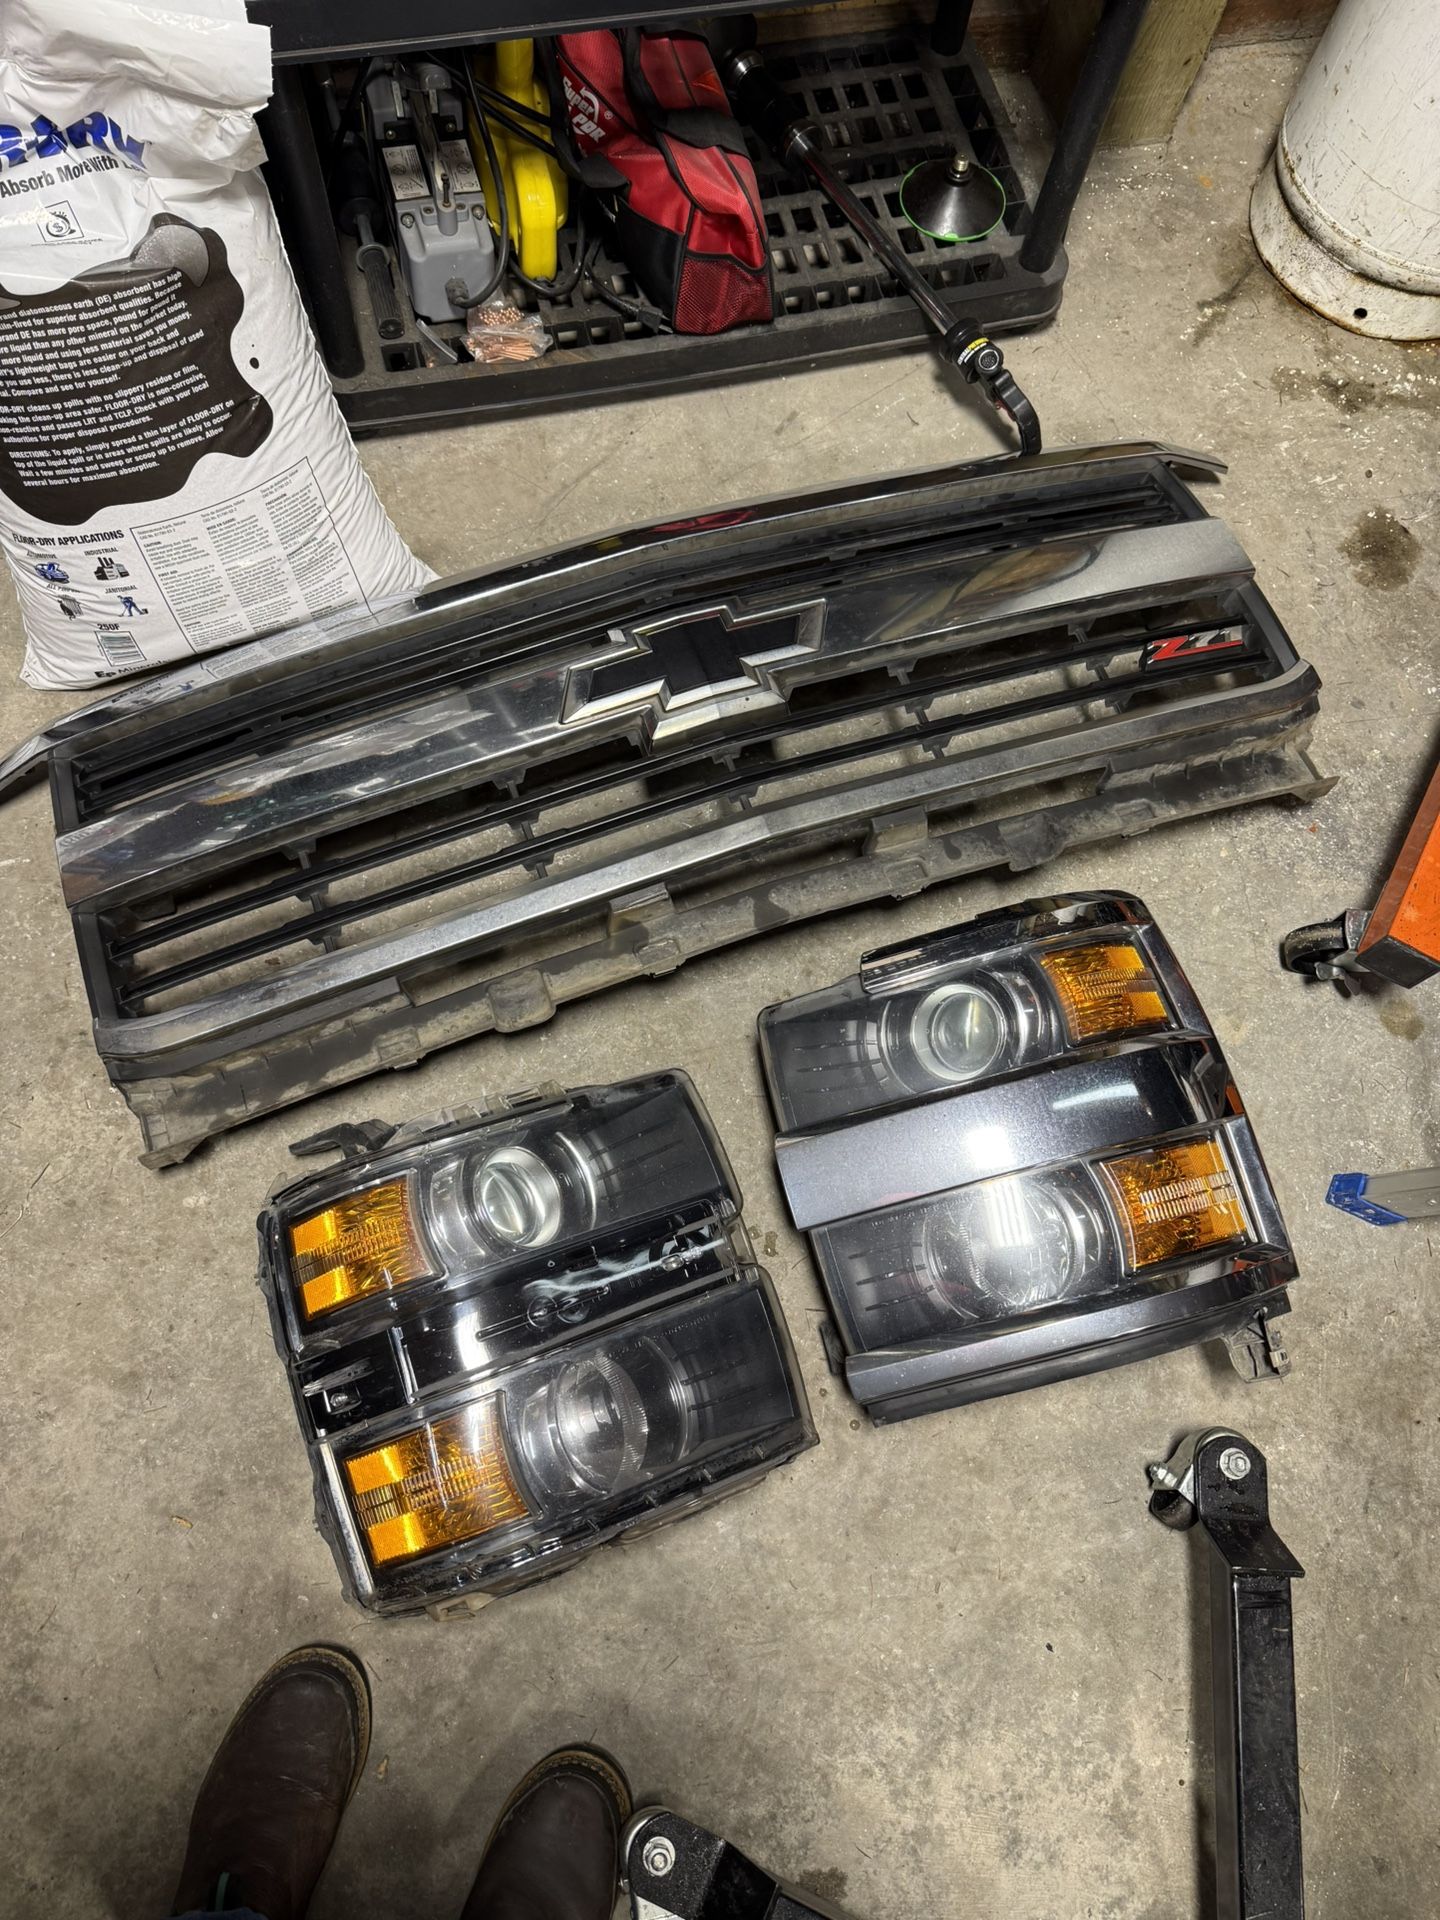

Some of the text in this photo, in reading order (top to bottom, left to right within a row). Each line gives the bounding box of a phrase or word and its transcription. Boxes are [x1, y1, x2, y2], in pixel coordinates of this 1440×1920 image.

[563, 76, 594, 115] Super
[571, 112, 606, 143] PDR
[0, 170, 55, 198] Absorb
[56, 158, 92, 183] More
[86, 155, 119, 172] With
[0, 270, 182, 321] rand diatomaceous earth (DE) absorbent has high
[46, 314, 76, 324] superior
[79, 304, 117, 320] absorbent
[119, 295, 154, 310] qualities.
[154, 282, 182, 299] Because
[2, 311, 192, 365] more liquid and using less material saves you money.
[10, 342, 32, 352] liquid
[66, 336, 86, 345] other
[88, 328, 118, 341] mineral
[120, 326, 129, 334] on
[130, 323, 142, 331] the
[143, 310, 167, 326] market
[167, 300, 188, 313] today.
[20, 331, 31, 339] DE
[47, 327, 66, 336] more
[68, 325, 85, 335] pore
[86, 320, 112, 330] space,
[113, 311, 137, 325] pound
[138, 308, 149, 317] for
[150, 297, 170, 312] pound
[15, 363, 58, 376] lightweight
[93, 353, 116, 363] easier
[119, 350, 128, 358] on
[130, 344, 146, 355] your
[147, 336, 165, 347] back
[166, 328, 179, 340] and
[33, 376, 52, 384] less,
[52, 373, 72, 382] there
[82, 368, 98, 376] less
[100, 359, 132, 373] clean-up
[134, 352, 147, 362] and
[148, 341, 179, 357] disposal
[180, 337, 187, 346] of
[188, 328, 204, 342] used
[11, 388, 43, 396] Compare
[45, 384, 59, 394] and
[60, 383, 74, 391] see
[87, 374, 120, 388] yourself.
[18, 414, 31, 422] the
[32, 413, 64, 422] clean-up
[83, 407, 104, 415] safer.
[104, 394, 146, 411] FLOOR-DRY
[156, 372, 206, 396] non-corrosive,
[27, 403, 51, 412] cleans
[63, 399, 84, 408] spills
[85, 395, 102, 404] with
[114, 384, 144, 398] slippery
[146, 375, 172, 389] residue
[182, 365, 199, 375] film,
[56, 421, 82, 430] passes
[83, 417, 97, 425] LRT
[99, 414, 113, 423] and
[114, 410, 134, 420] TCLP.
[134, 402, 157, 414] Check
[158, 396, 174, 406] with
[175, 389, 191, 401] your
[192, 381, 209, 392] local
[9, 450, 52, 458] DIRECTIONS:
[63, 446, 85, 456] apply,
[85, 442, 110, 452] simply
[111, 435, 137, 447] spread
[144, 429, 159, 438] thin
[159, 423, 178, 434] layer
[187, 403, 224, 424] FLOOR-DRY
[225, 399, 234, 407] on
[47, 459, 68, 467] liquid
[69, 456, 84, 464] spill
[104, 450, 125, 458] areas
[126, 443, 149, 454] where
[150, 436, 170, 447] spills
[171, 432, 183, 440] are
[183, 424, 203, 436] likely
[212, 412, 232, 424] occur.
[51, 432, 75, 441] proper
[77, 426, 108, 436] disposal
[109, 415, 153, 432] procedures.
[55, 466, 84, 475] minutes
[100, 460, 124, 468] sweep
[134, 450, 156, 462] scoop
[158, 447, 167, 456] up
[176, 435, 205, 448] remove.
[206, 426, 224, 438] Allow
[48, 477, 69, 485] hours
[82, 470, 118, 482] maximum
[119, 461, 160, 475] absorption.
[12, 533, 56, 546] FLOOR-DRY
[58, 530, 124, 545] APPLICATIONS
[84, 547, 118, 556] INDUSTRIAL
[105, 585, 138, 594] JANITORIAL
[1147, 625, 1244, 663] Z71
